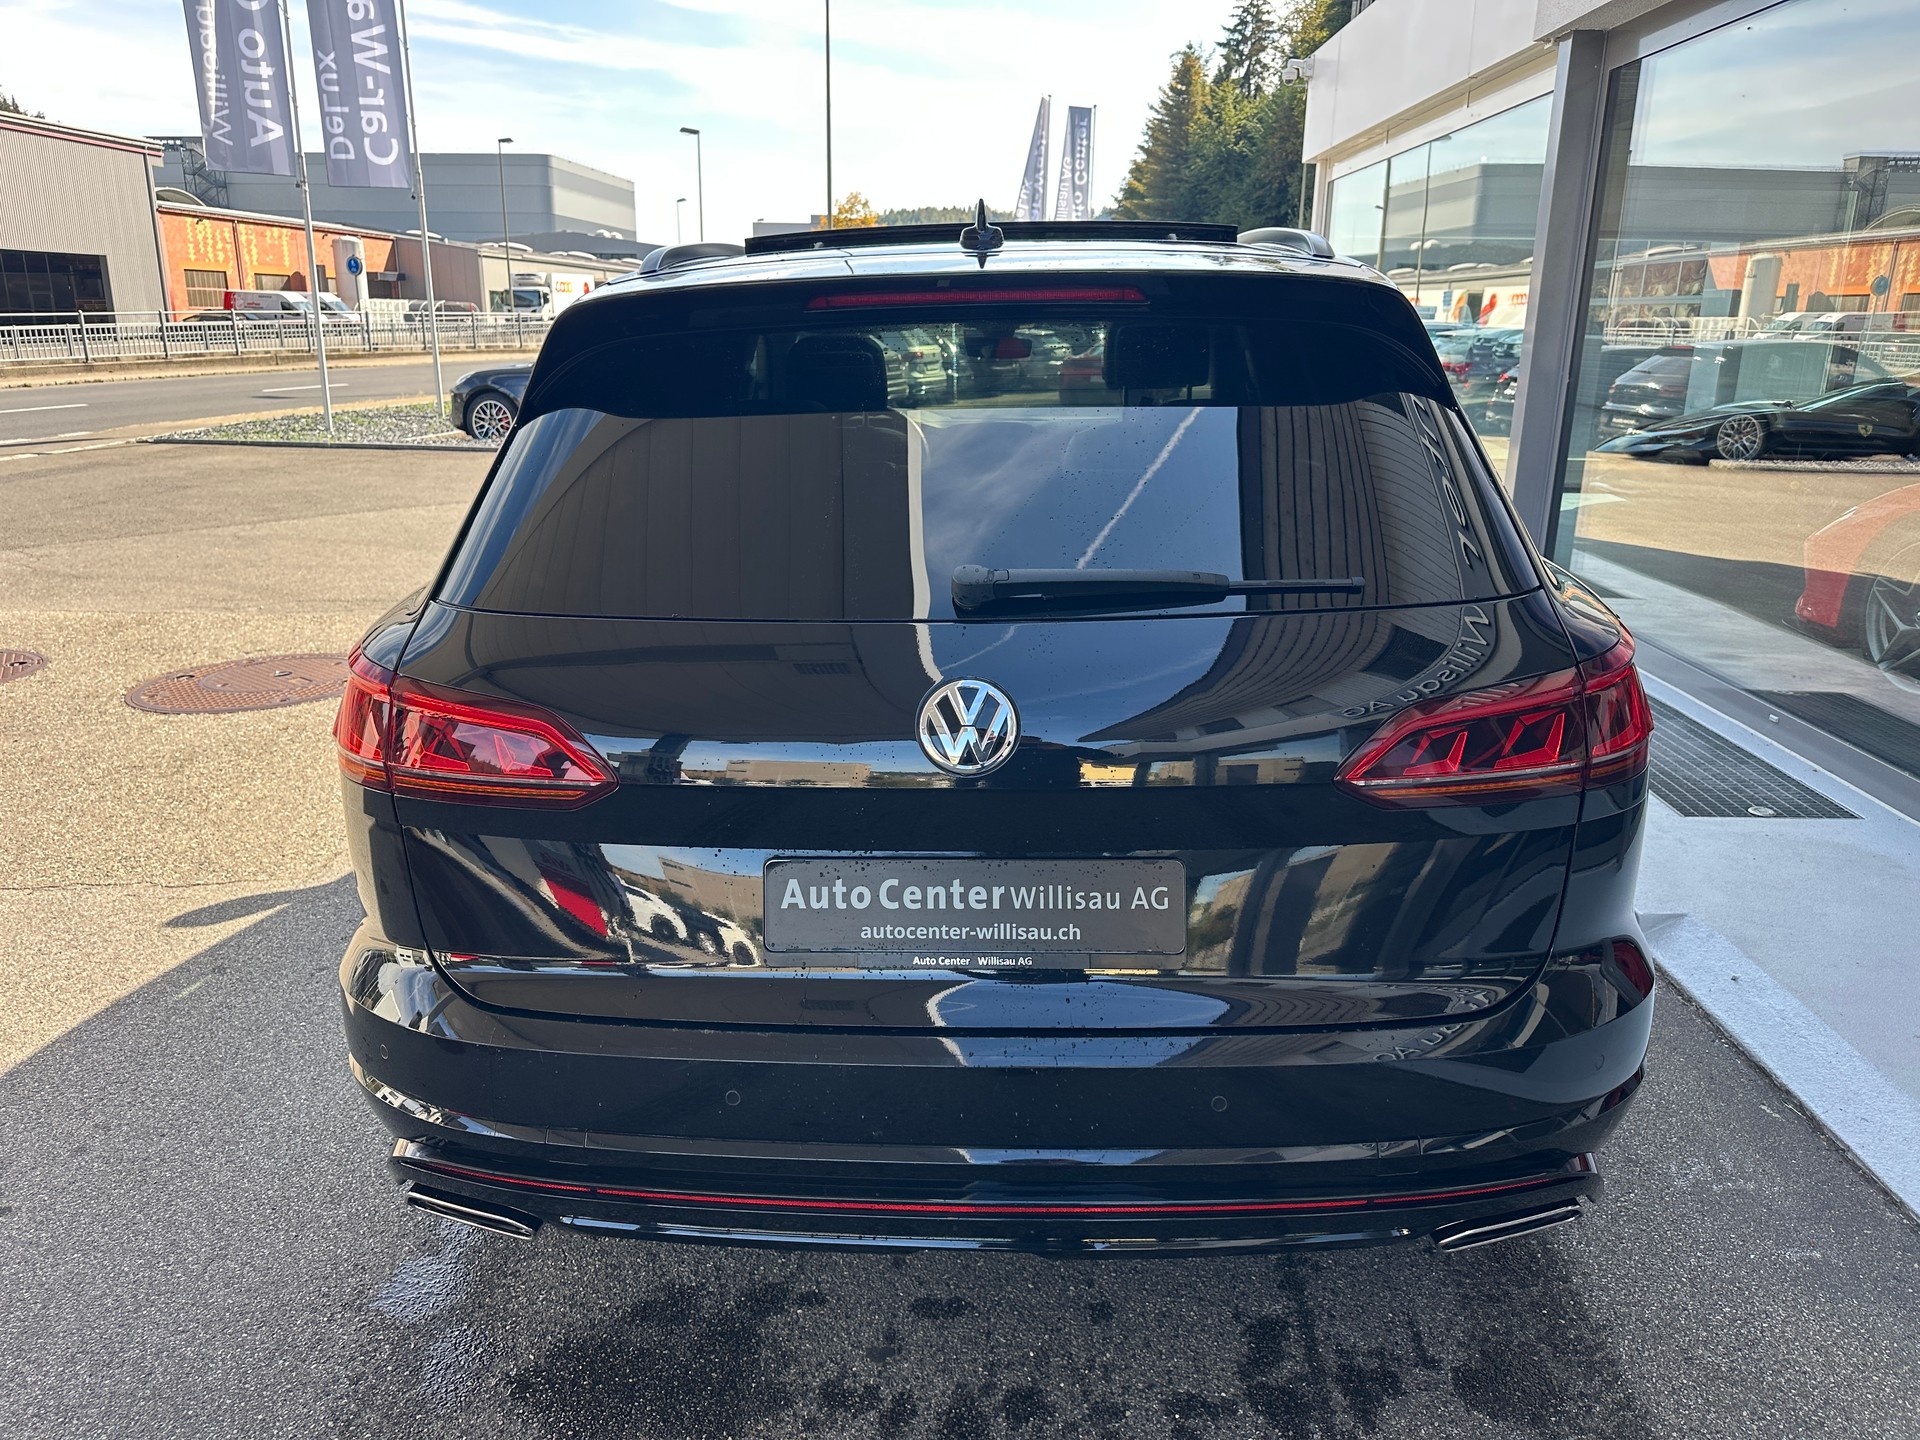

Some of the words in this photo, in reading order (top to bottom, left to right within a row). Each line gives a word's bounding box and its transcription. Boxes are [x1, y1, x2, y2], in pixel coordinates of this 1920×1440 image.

[781, 878, 872, 910] Auto
[880, 877, 1005, 911] Center
[1010, 884, 1120, 911] Willisau
[1131, 886, 1169, 911] AG
[860, 923, 1081, 941] autocenter-willisau.ch
[912, 957, 936, 966] Auto
[938, 957, 970, 966] Center
[978, 957, 1016, 966] Willisau
[1018, 957, 1032, 966] AG
